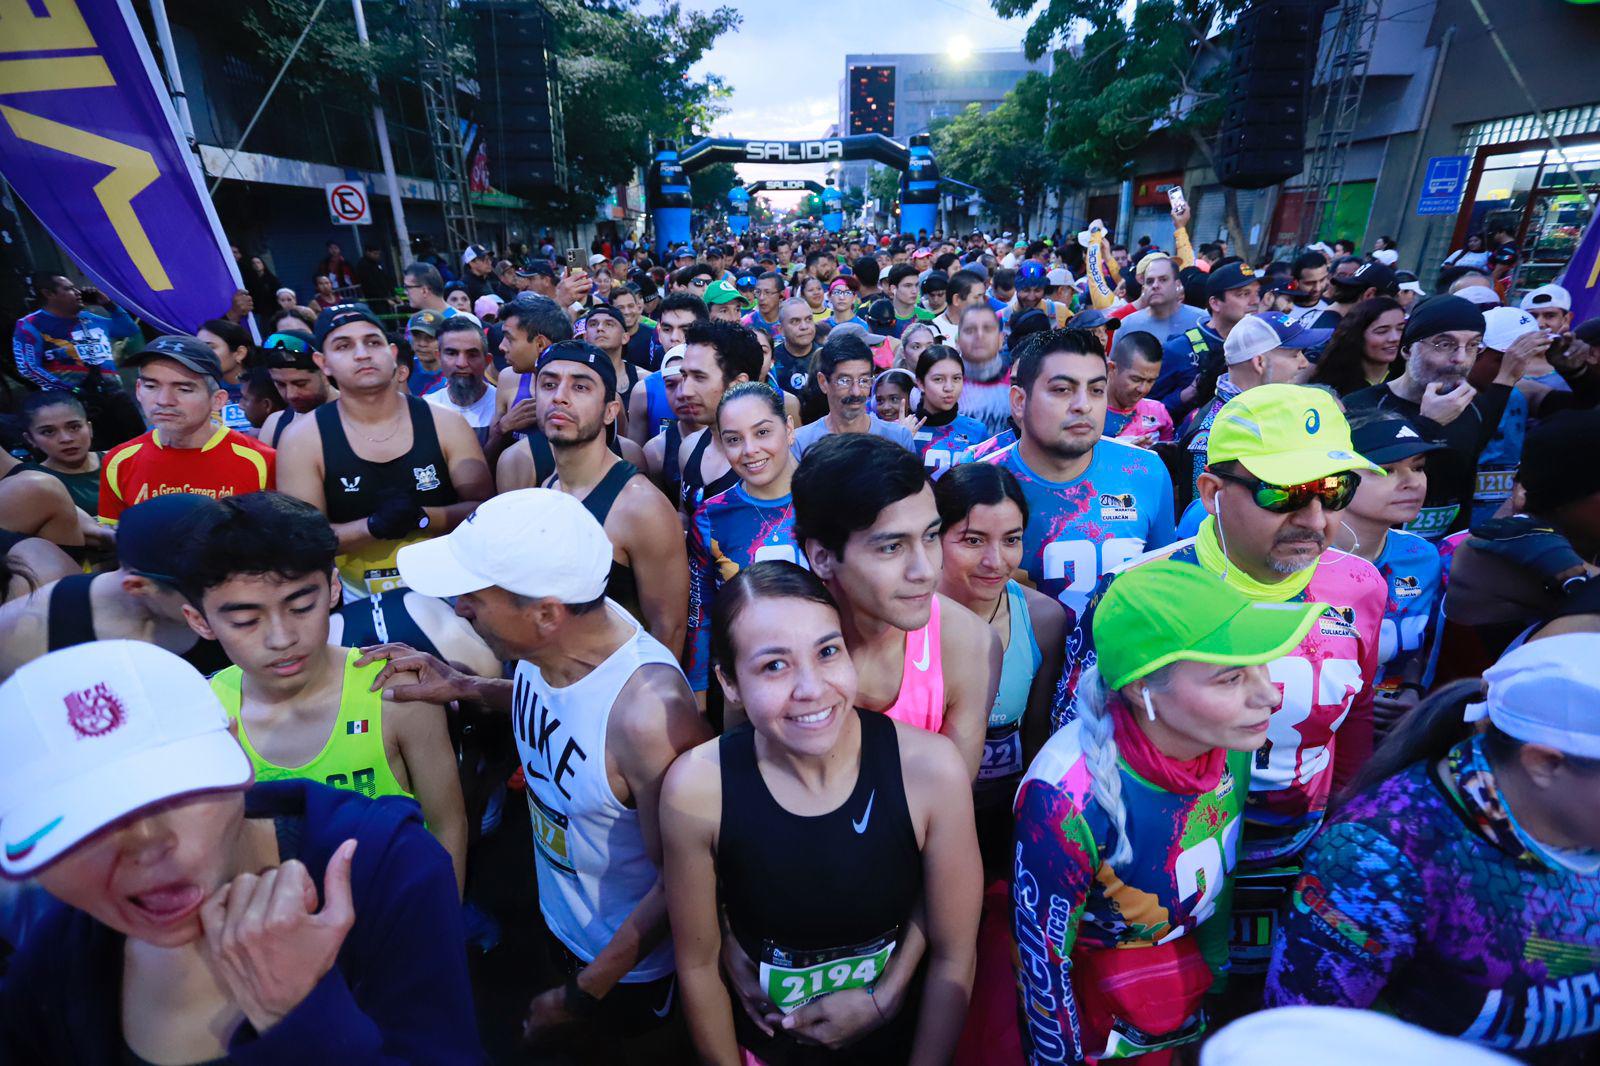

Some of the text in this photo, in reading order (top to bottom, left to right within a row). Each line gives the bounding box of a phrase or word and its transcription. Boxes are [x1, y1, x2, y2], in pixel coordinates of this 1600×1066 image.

[746, 140, 843, 160] SALIDA
[766, 181, 805, 190] SALIDA
[1478, 474, 1514, 491] 1216
[513, 672, 587, 801] NIKE
[781, 958, 877, 1004] 2194
